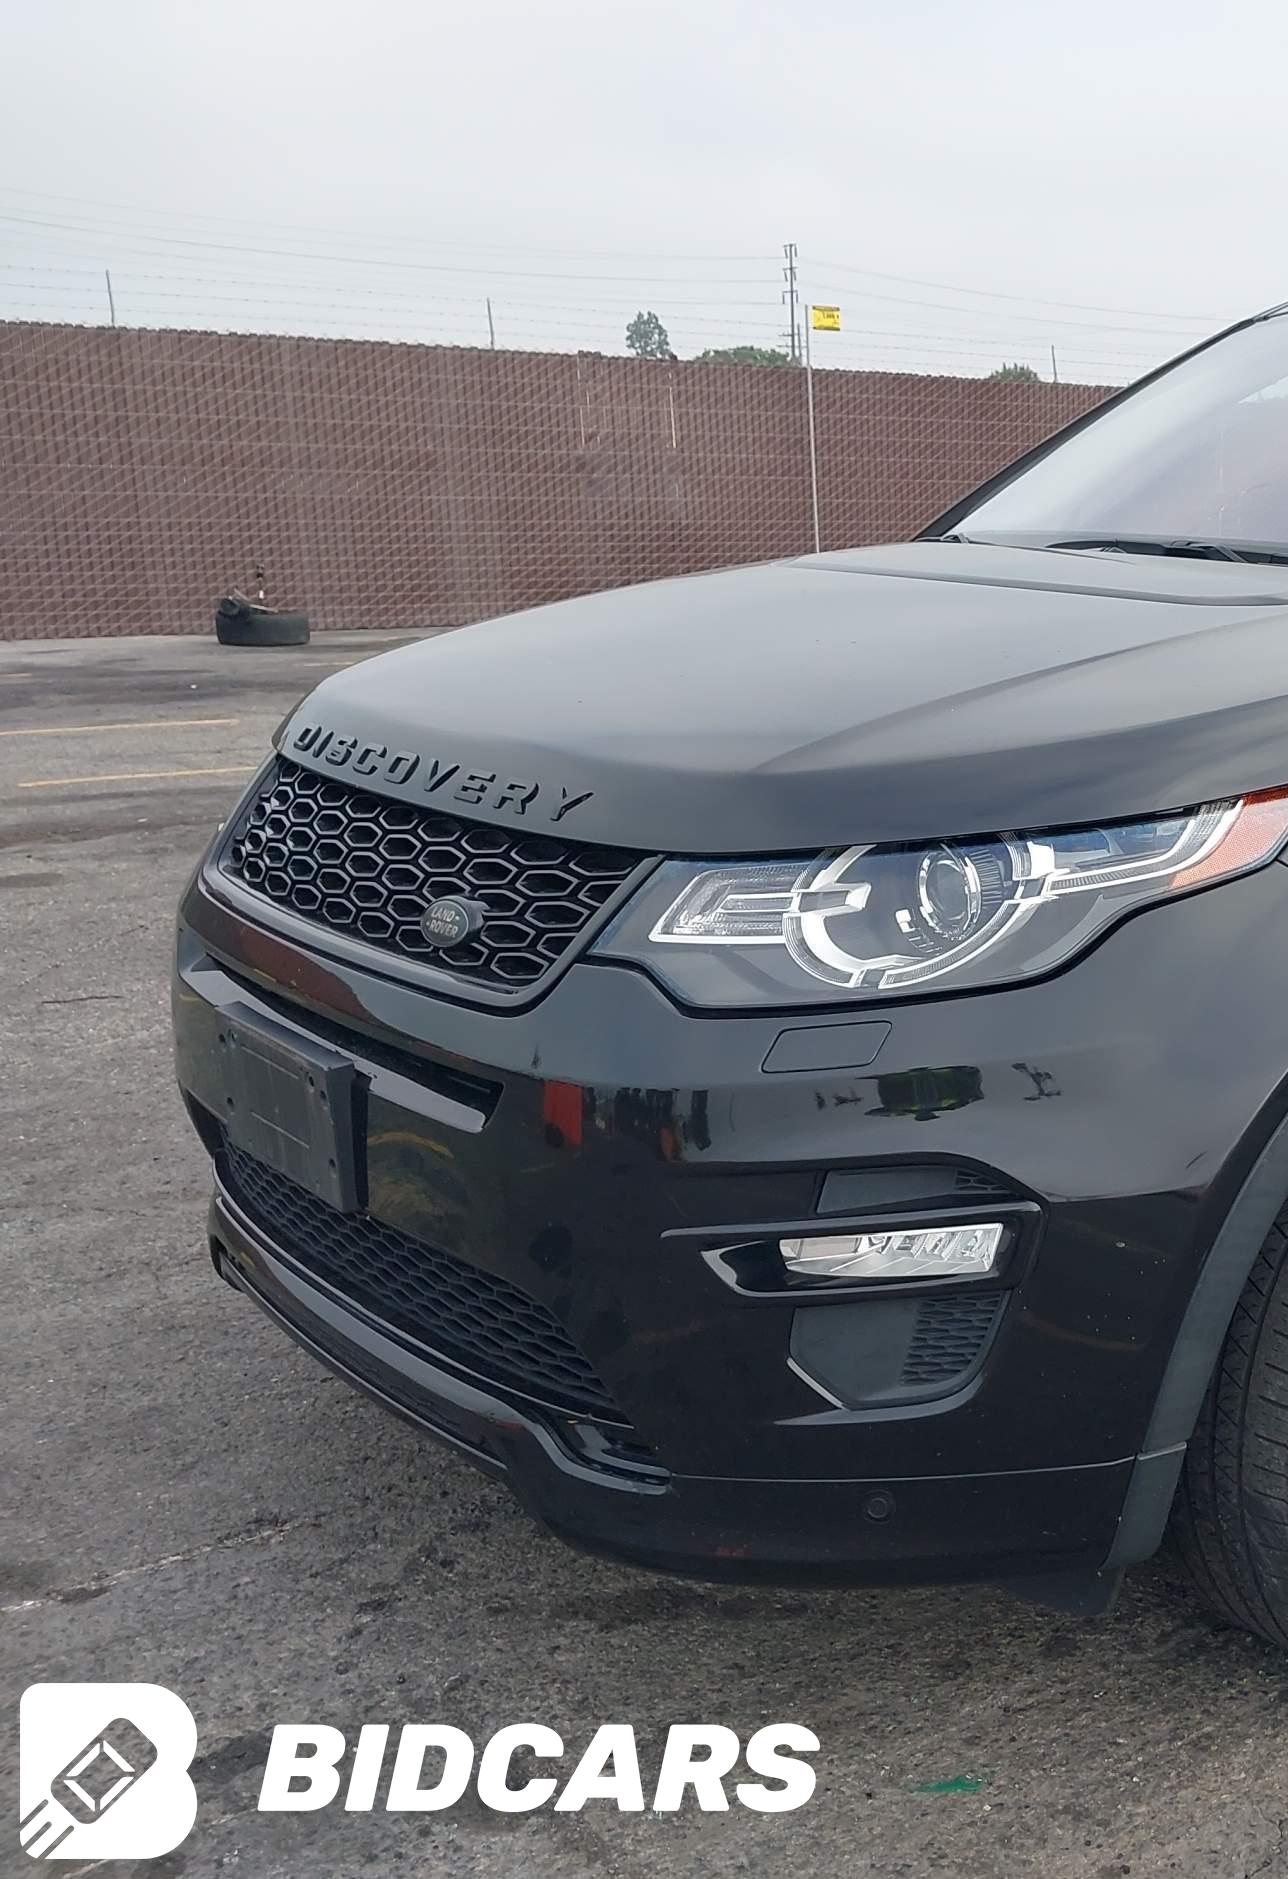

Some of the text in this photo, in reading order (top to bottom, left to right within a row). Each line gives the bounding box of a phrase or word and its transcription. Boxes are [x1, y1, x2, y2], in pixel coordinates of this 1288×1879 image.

[293, 723, 595, 822] DISCOVERY
[431, 906, 456, 922] LAND
[430, 919, 459, 938] ROVER
